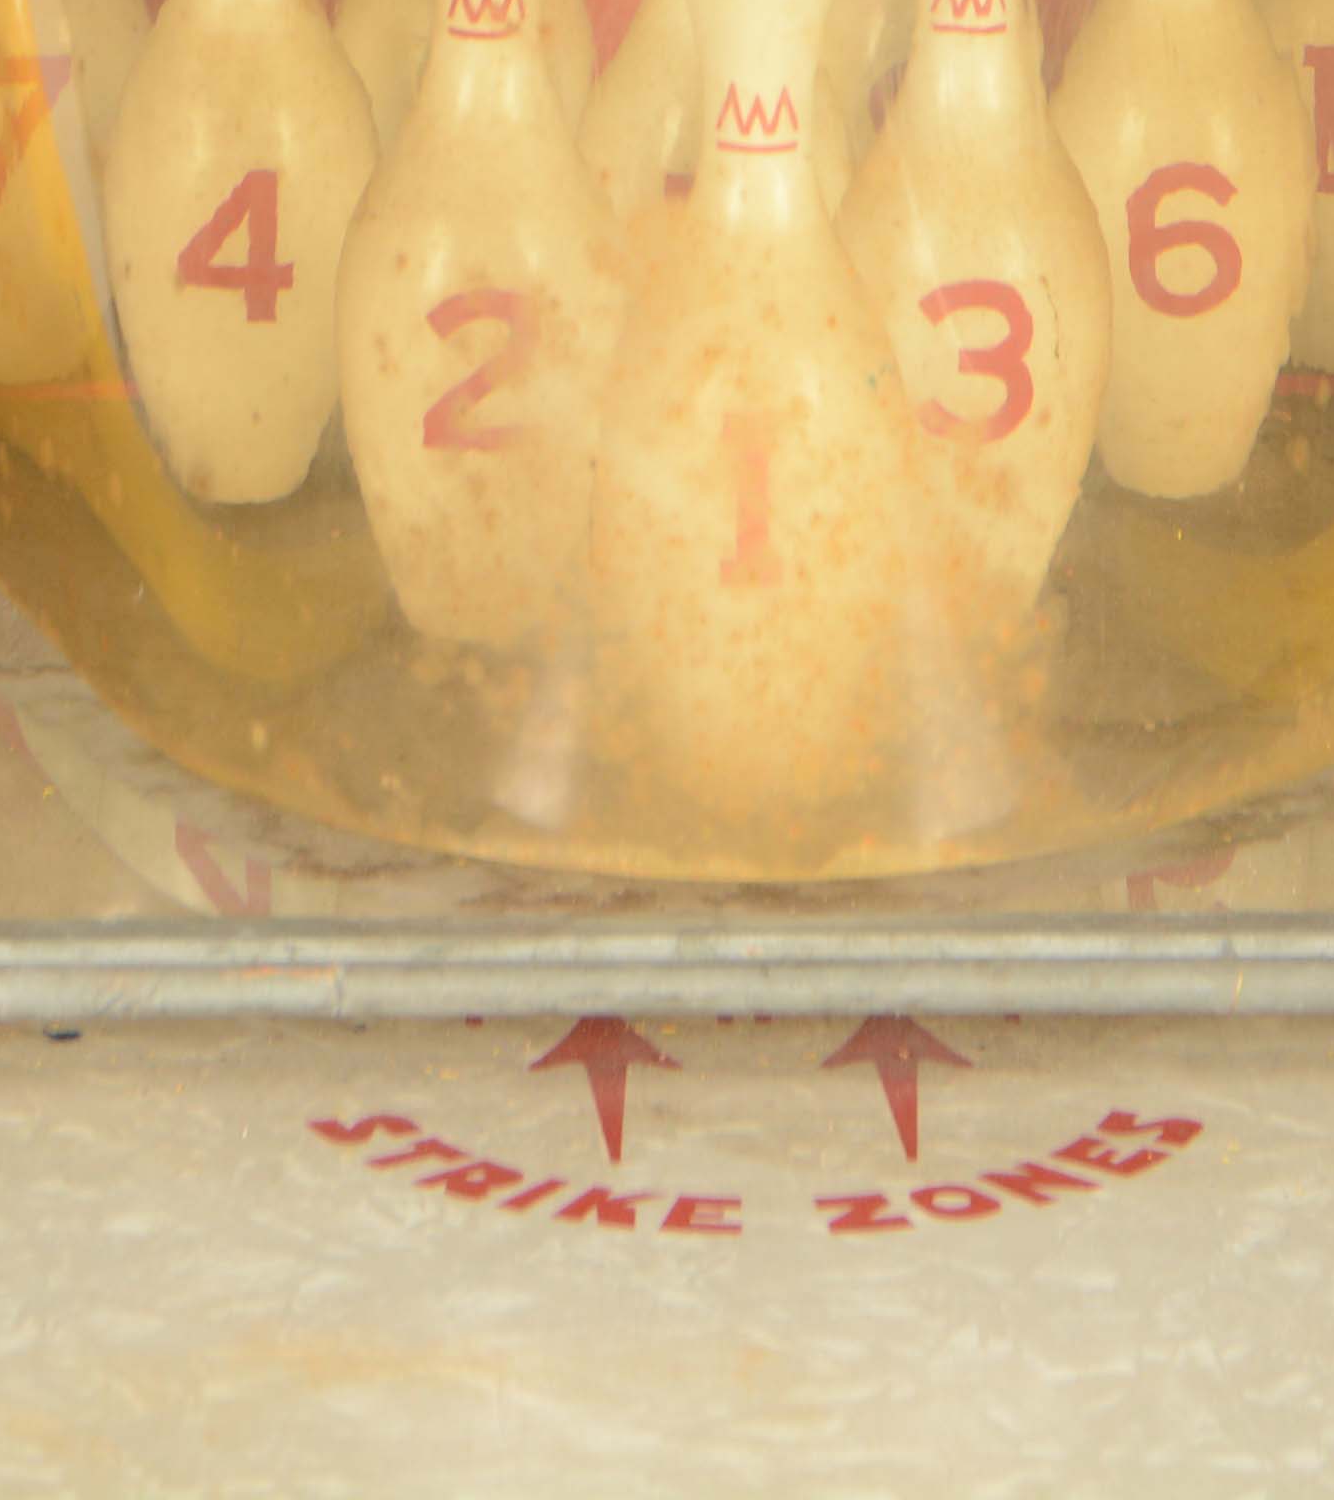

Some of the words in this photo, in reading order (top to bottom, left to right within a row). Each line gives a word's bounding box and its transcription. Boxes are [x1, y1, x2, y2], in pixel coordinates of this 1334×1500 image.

[176, 169, 295, 323] 4
[1125, 162, 1243, 318] 6
[422, 289, 541, 450] 2
[917, 278, 1034, 444] 3
[719, 412, 784, 588] 1
[308, 1111, 743, 1234] STRIKE
[814, 1109, 1203, 1235] ZONES
